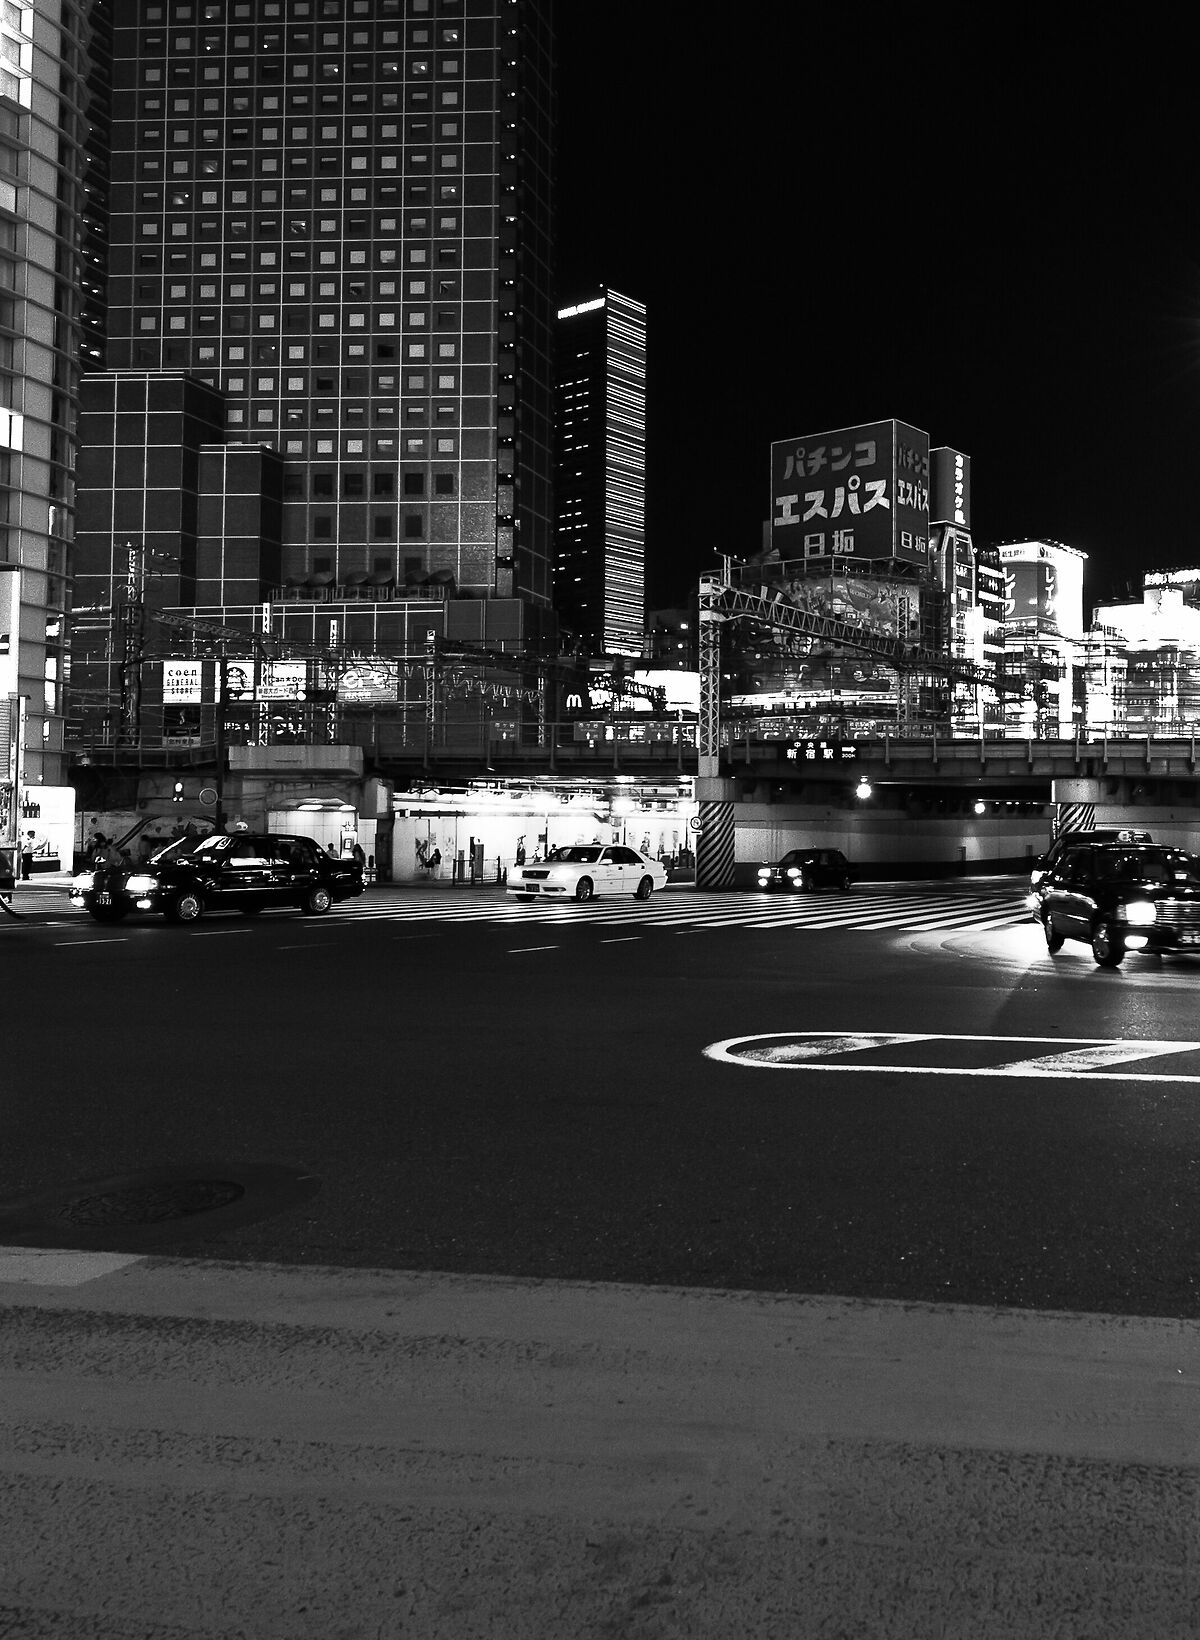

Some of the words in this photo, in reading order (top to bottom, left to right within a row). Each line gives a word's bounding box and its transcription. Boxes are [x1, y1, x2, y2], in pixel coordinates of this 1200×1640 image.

[784, 440, 876, 480] パチンコ
[899, 442, 928, 477] パチンコ
[774, 474, 890, 526] エスパス
[898, 480, 929, 511] エスパス
[786, 748, 834, 760] 新宿駅
